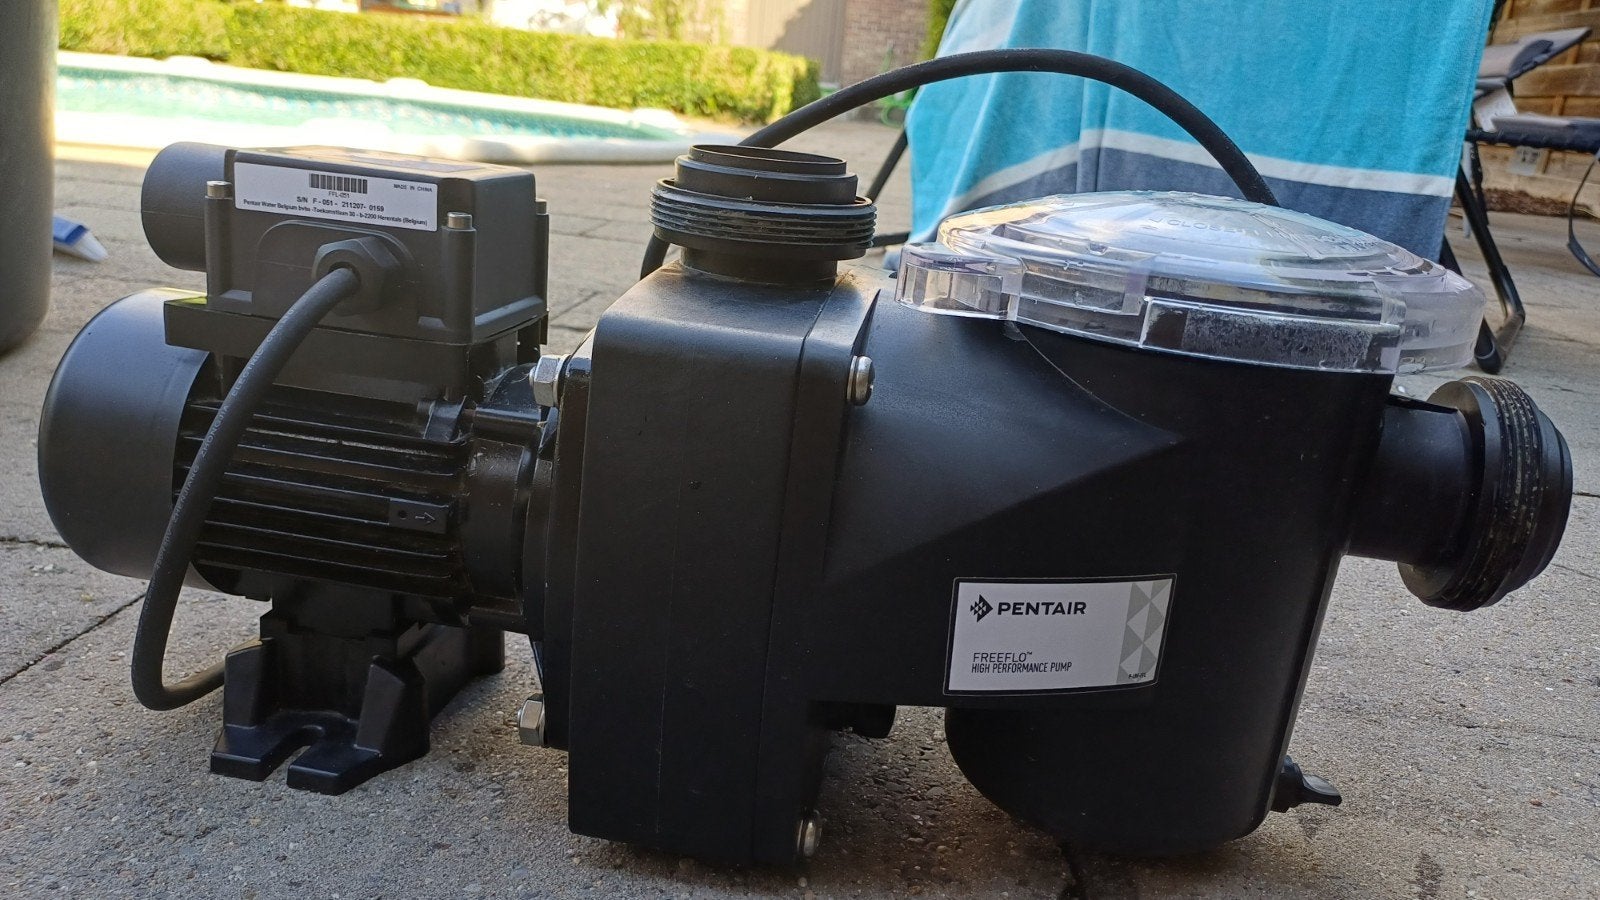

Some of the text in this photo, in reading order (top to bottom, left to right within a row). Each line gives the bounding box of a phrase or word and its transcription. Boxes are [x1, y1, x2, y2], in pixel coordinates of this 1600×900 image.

[243, 198, 261, 206] Pentair
[261, 200, 276, 208] Water
[277, 202, 297, 211] Belgium
[377, 214, 402, 223] Herentals
[402, 216, 428, 226] (Belgium)
[296, 196, 308, 204] S/N
[368, 204, 384, 212] 0159
[231, 346, 265, 397] ELECTRIC
[997, 601, 1087, 616] PENTAIR
[971, 661, 1073, 674] HIGH PERFORMANCE PUMP
